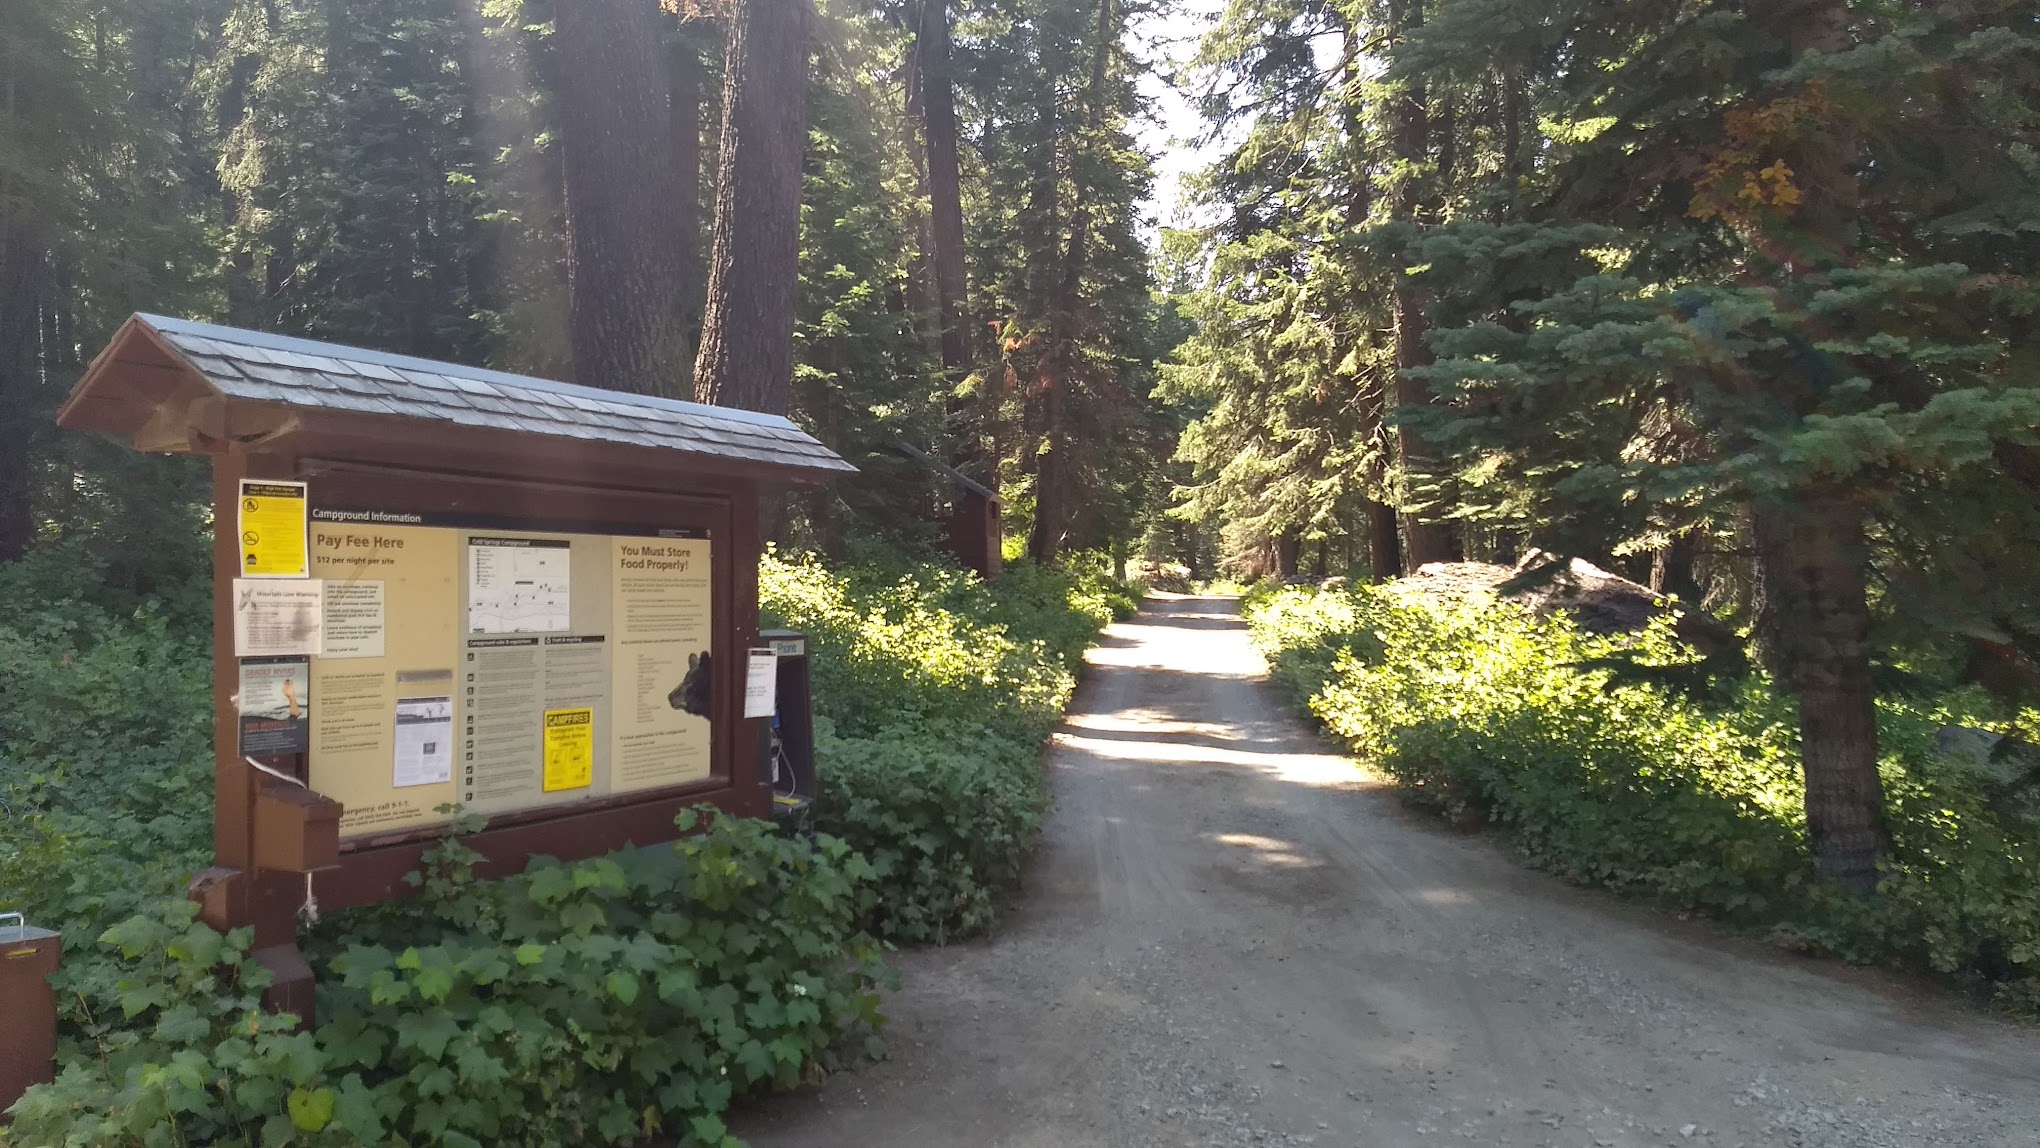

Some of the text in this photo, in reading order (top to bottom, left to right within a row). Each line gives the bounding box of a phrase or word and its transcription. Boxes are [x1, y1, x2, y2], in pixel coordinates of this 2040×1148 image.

[313, 509, 422, 523] Campground Information
[317, 534, 404, 549] Pay Fee Here
[621, 545, 691, 558] You Must Store
[317, 556, 329, 564] $12
[332, 557, 344, 565] per
[347, 557, 366, 565] night
[621, 558, 688, 572] Food Properly!
[548, 713, 589, 726] CAMPFIRES
[378, 803, 390, 811] call
